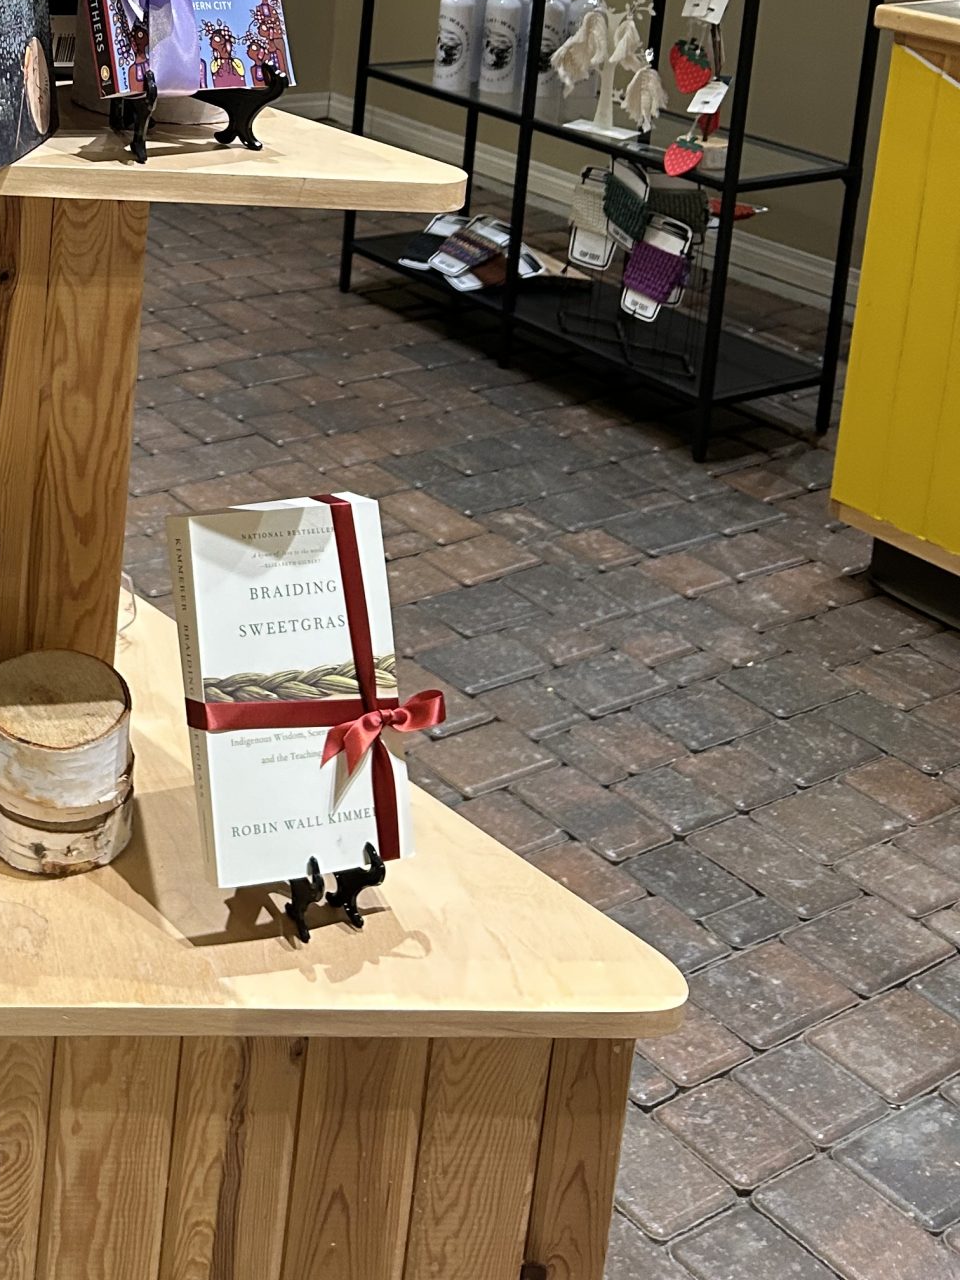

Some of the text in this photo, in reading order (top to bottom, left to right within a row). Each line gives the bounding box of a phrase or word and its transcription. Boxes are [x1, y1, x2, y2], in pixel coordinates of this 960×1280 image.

[214, 1, 232, 11] CITY
[241, 530, 283, 540] NATIONAL
[175, 538, 187, 612] KIMMERER
[249, 580, 338, 601] BRAIDING
[238, 614, 346, 638] SWEETGRAS
[231, 730, 307, 748] Indigenous Wisdom,
[261, 752, 288, 765] and the
[231, 821, 278, 838] ROBIN
[284, 816, 324, 831] WALL
